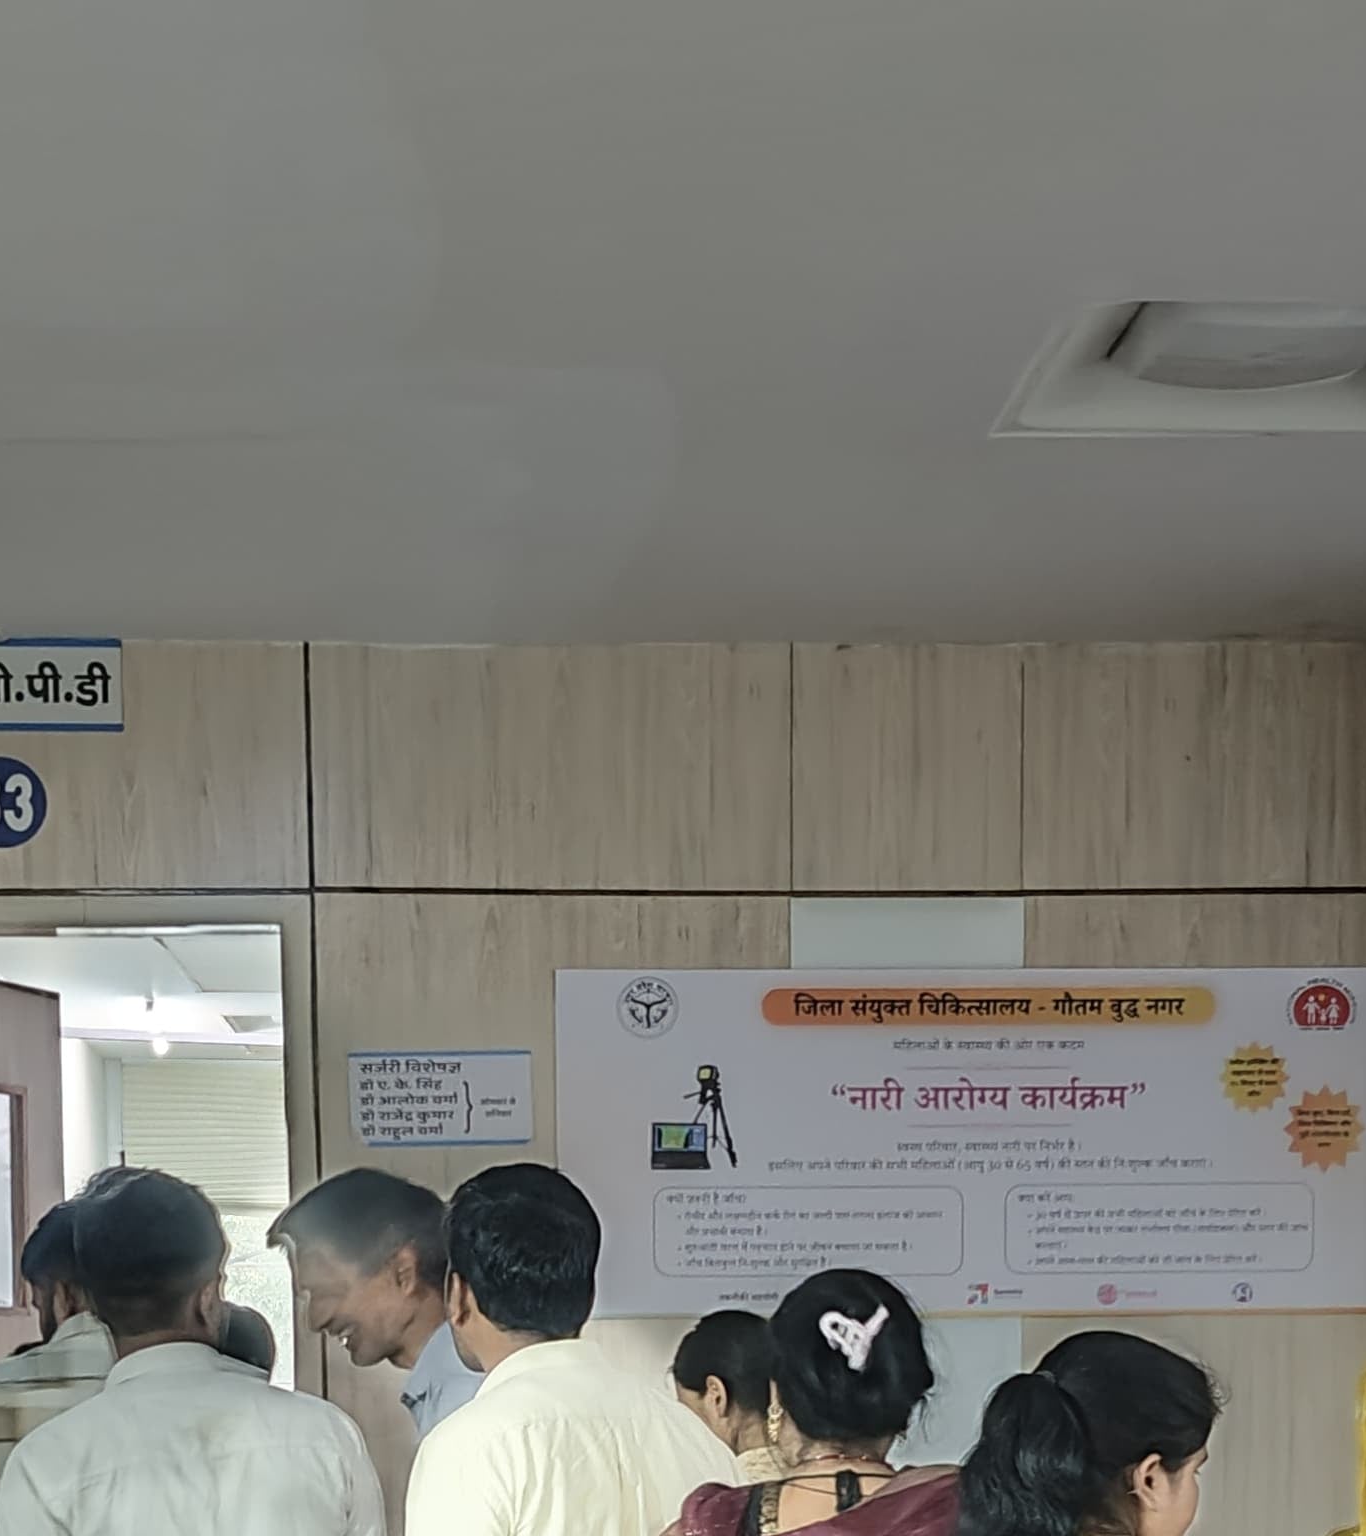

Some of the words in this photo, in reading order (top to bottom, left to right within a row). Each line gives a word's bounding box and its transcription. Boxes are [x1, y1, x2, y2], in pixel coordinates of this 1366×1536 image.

[793, 993, 843, 1018] जिला
[849, 993, 911, 1024] संयुक्त
[917, 991, 1032, 1018] चिकित्सालय
[1052, 991, 1104, 1017] गौतम
[1145, 998, 1185, 1017] नगर
[360, 1058, 401, 1073] सर्जरी
[405, 1058, 462, 1074] विशेषज्ञ
[416, 1077, 443, 1091] सिंह
[914, 1076, 1010, 1111] आरोग्य
[416, 1110, 454, 1125] कुमार
